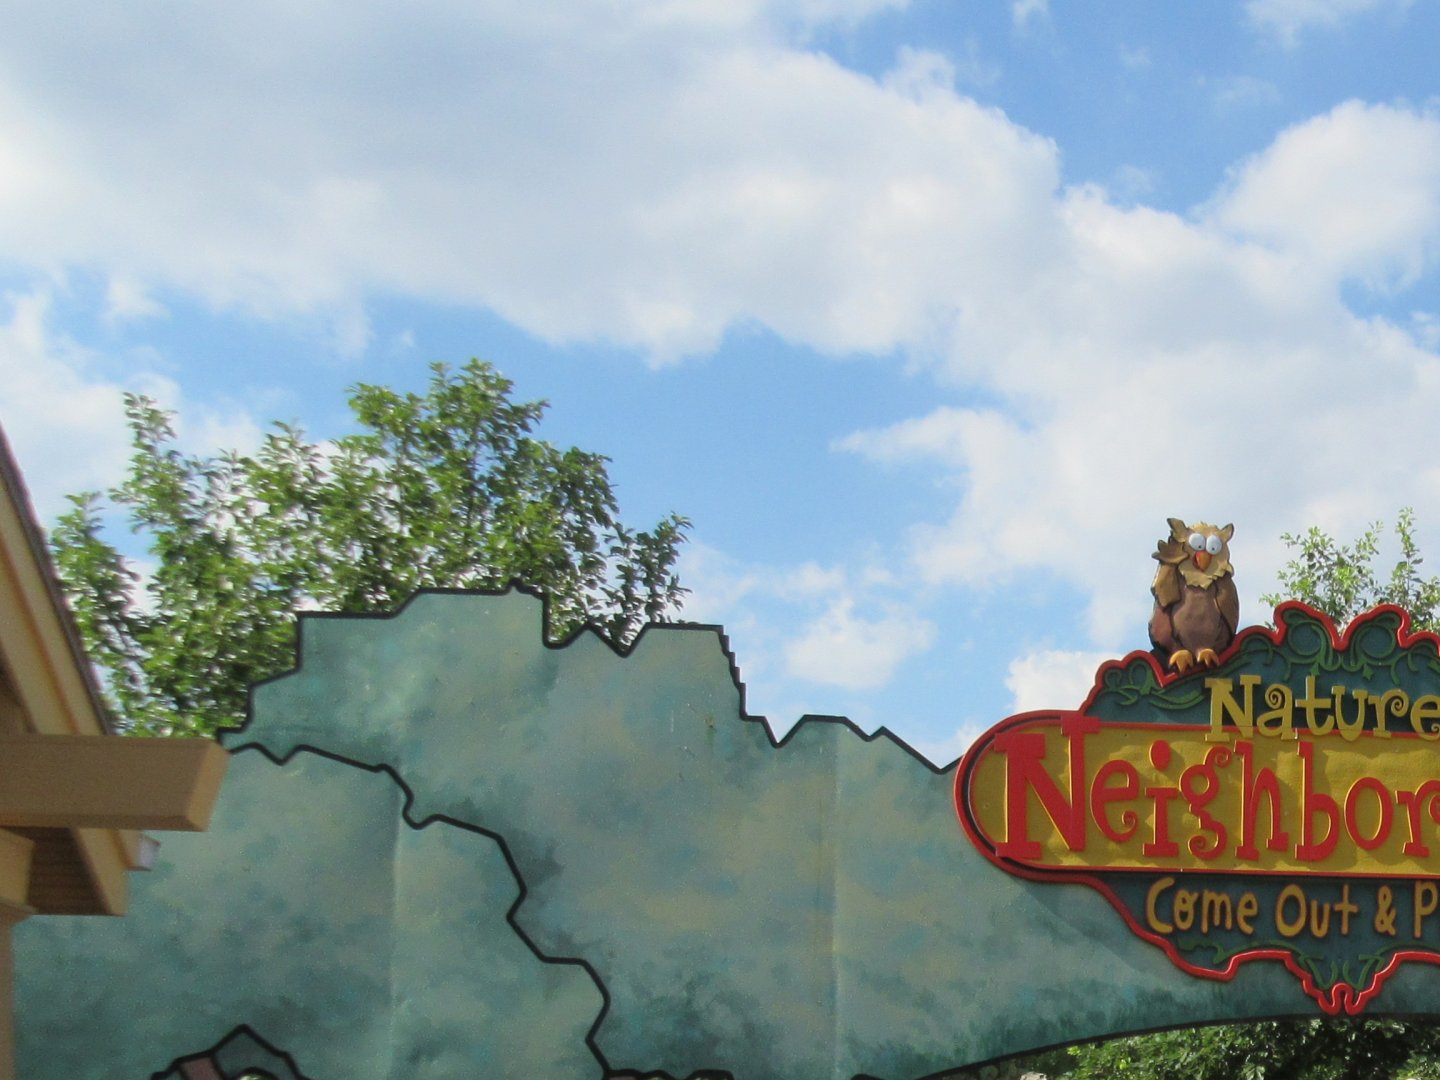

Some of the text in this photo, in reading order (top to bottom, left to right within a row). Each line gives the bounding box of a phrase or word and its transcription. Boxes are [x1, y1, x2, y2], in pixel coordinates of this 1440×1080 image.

[1145, 877, 1260, 934] Come
[1274, 883, 1360, 938] Out
[1373, 884, 1397, 936] &
